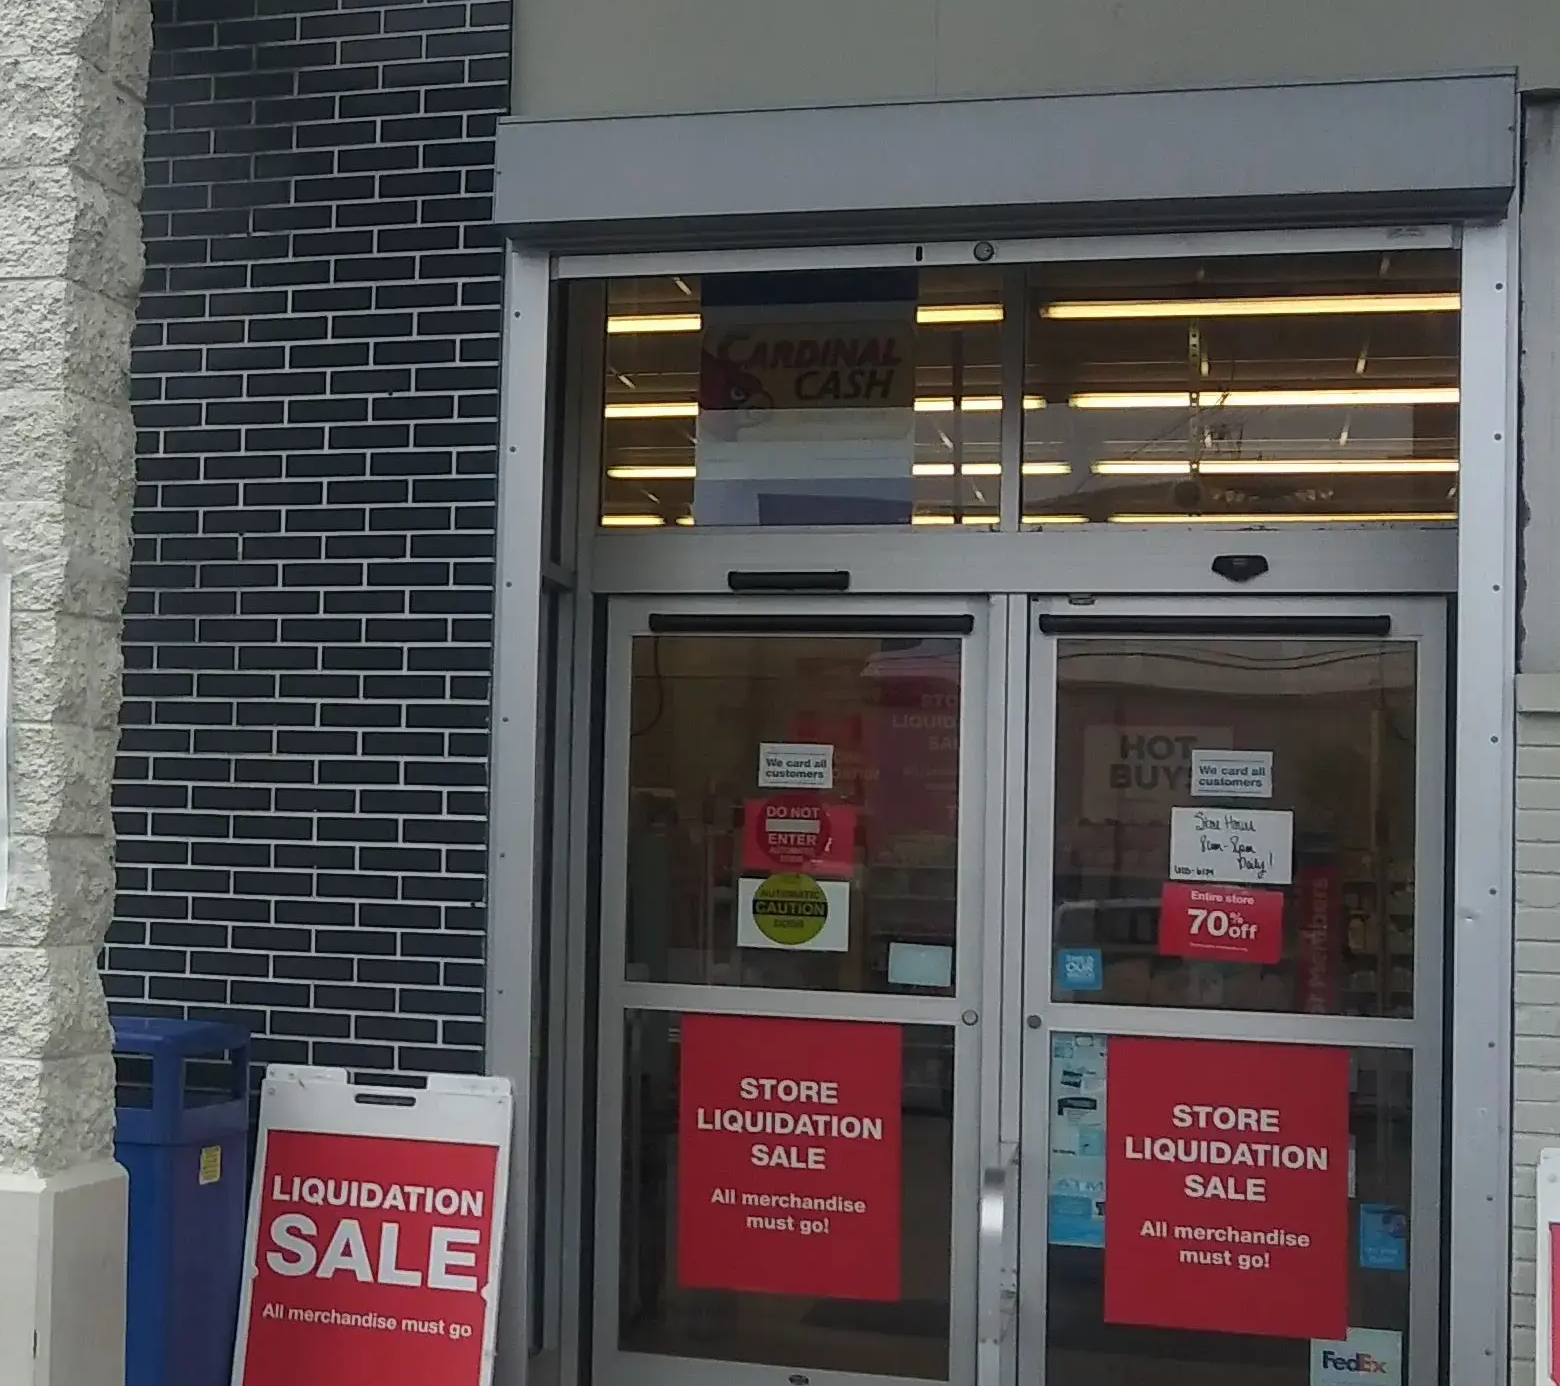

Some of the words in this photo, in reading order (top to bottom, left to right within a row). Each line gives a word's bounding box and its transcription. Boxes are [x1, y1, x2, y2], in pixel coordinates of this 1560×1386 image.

[718, 331, 902, 369] CARDINAL
[795, 371, 894, 400] CASH
[1121, 734, 1197, 760] HOT
[766, 758, 783, 768] We
[786, 758, 811, 768] card
[814, 758, 827, 768] all
[766, 769, 824, 779] customers
[1199, 765, 1218, 775] We
[1221, 765, 1248, 776] card
[1252, 766, 1265, 776] all
[1110, 764, 1190, 790] BUY
[1199, 777, 1262, 788] customers
[766, 806, 787, 818] DO
[791, 807, 820, 819] NOT
[768, 833, 817, 846] ENTER
[754, 900, 827, 916] CAUTION
[1191, 890, 1223, 902] Entire
[1225, 894, 1255, 905] store
[1229, 924, 1258, 940] off
[740, 1078, 838, 1104] STORE
[697, 1108, 882, 1140] LIQUIDATION
[1172, 1105, 1280, 1132] STORE
[751, 1144, 826, 1170] SALE
[1125, 1137, 1328, 1170] LIQUIDATION
[272, 1175, 484, 1217] LIQUIDATION
[711, 1189, 735, 1204] All
[742, 1192, 866, 1213] merchandise
[1184, 1175, 1266, 1201] SALE
[746, 1215, 794, 1230] must
[800, 1219, 829, 1235] go!
[1140, 1220, 1167, 1237] All
[1174, 1225, 1311, 1247] merchandise
[266, 1213, 481, 1292] SALE
[1179, 1250, 1232, 1267] must
[1238, 1253, 1270, 1270] go!
[263, 1302, 284, 1319] All
[288, 1307, 397, 1330] merchandise
[402, 1319, 445, 1334] must
[449, 1323, 472, 1338] go
[1322, 1350, 1387, 1373] FedEx
